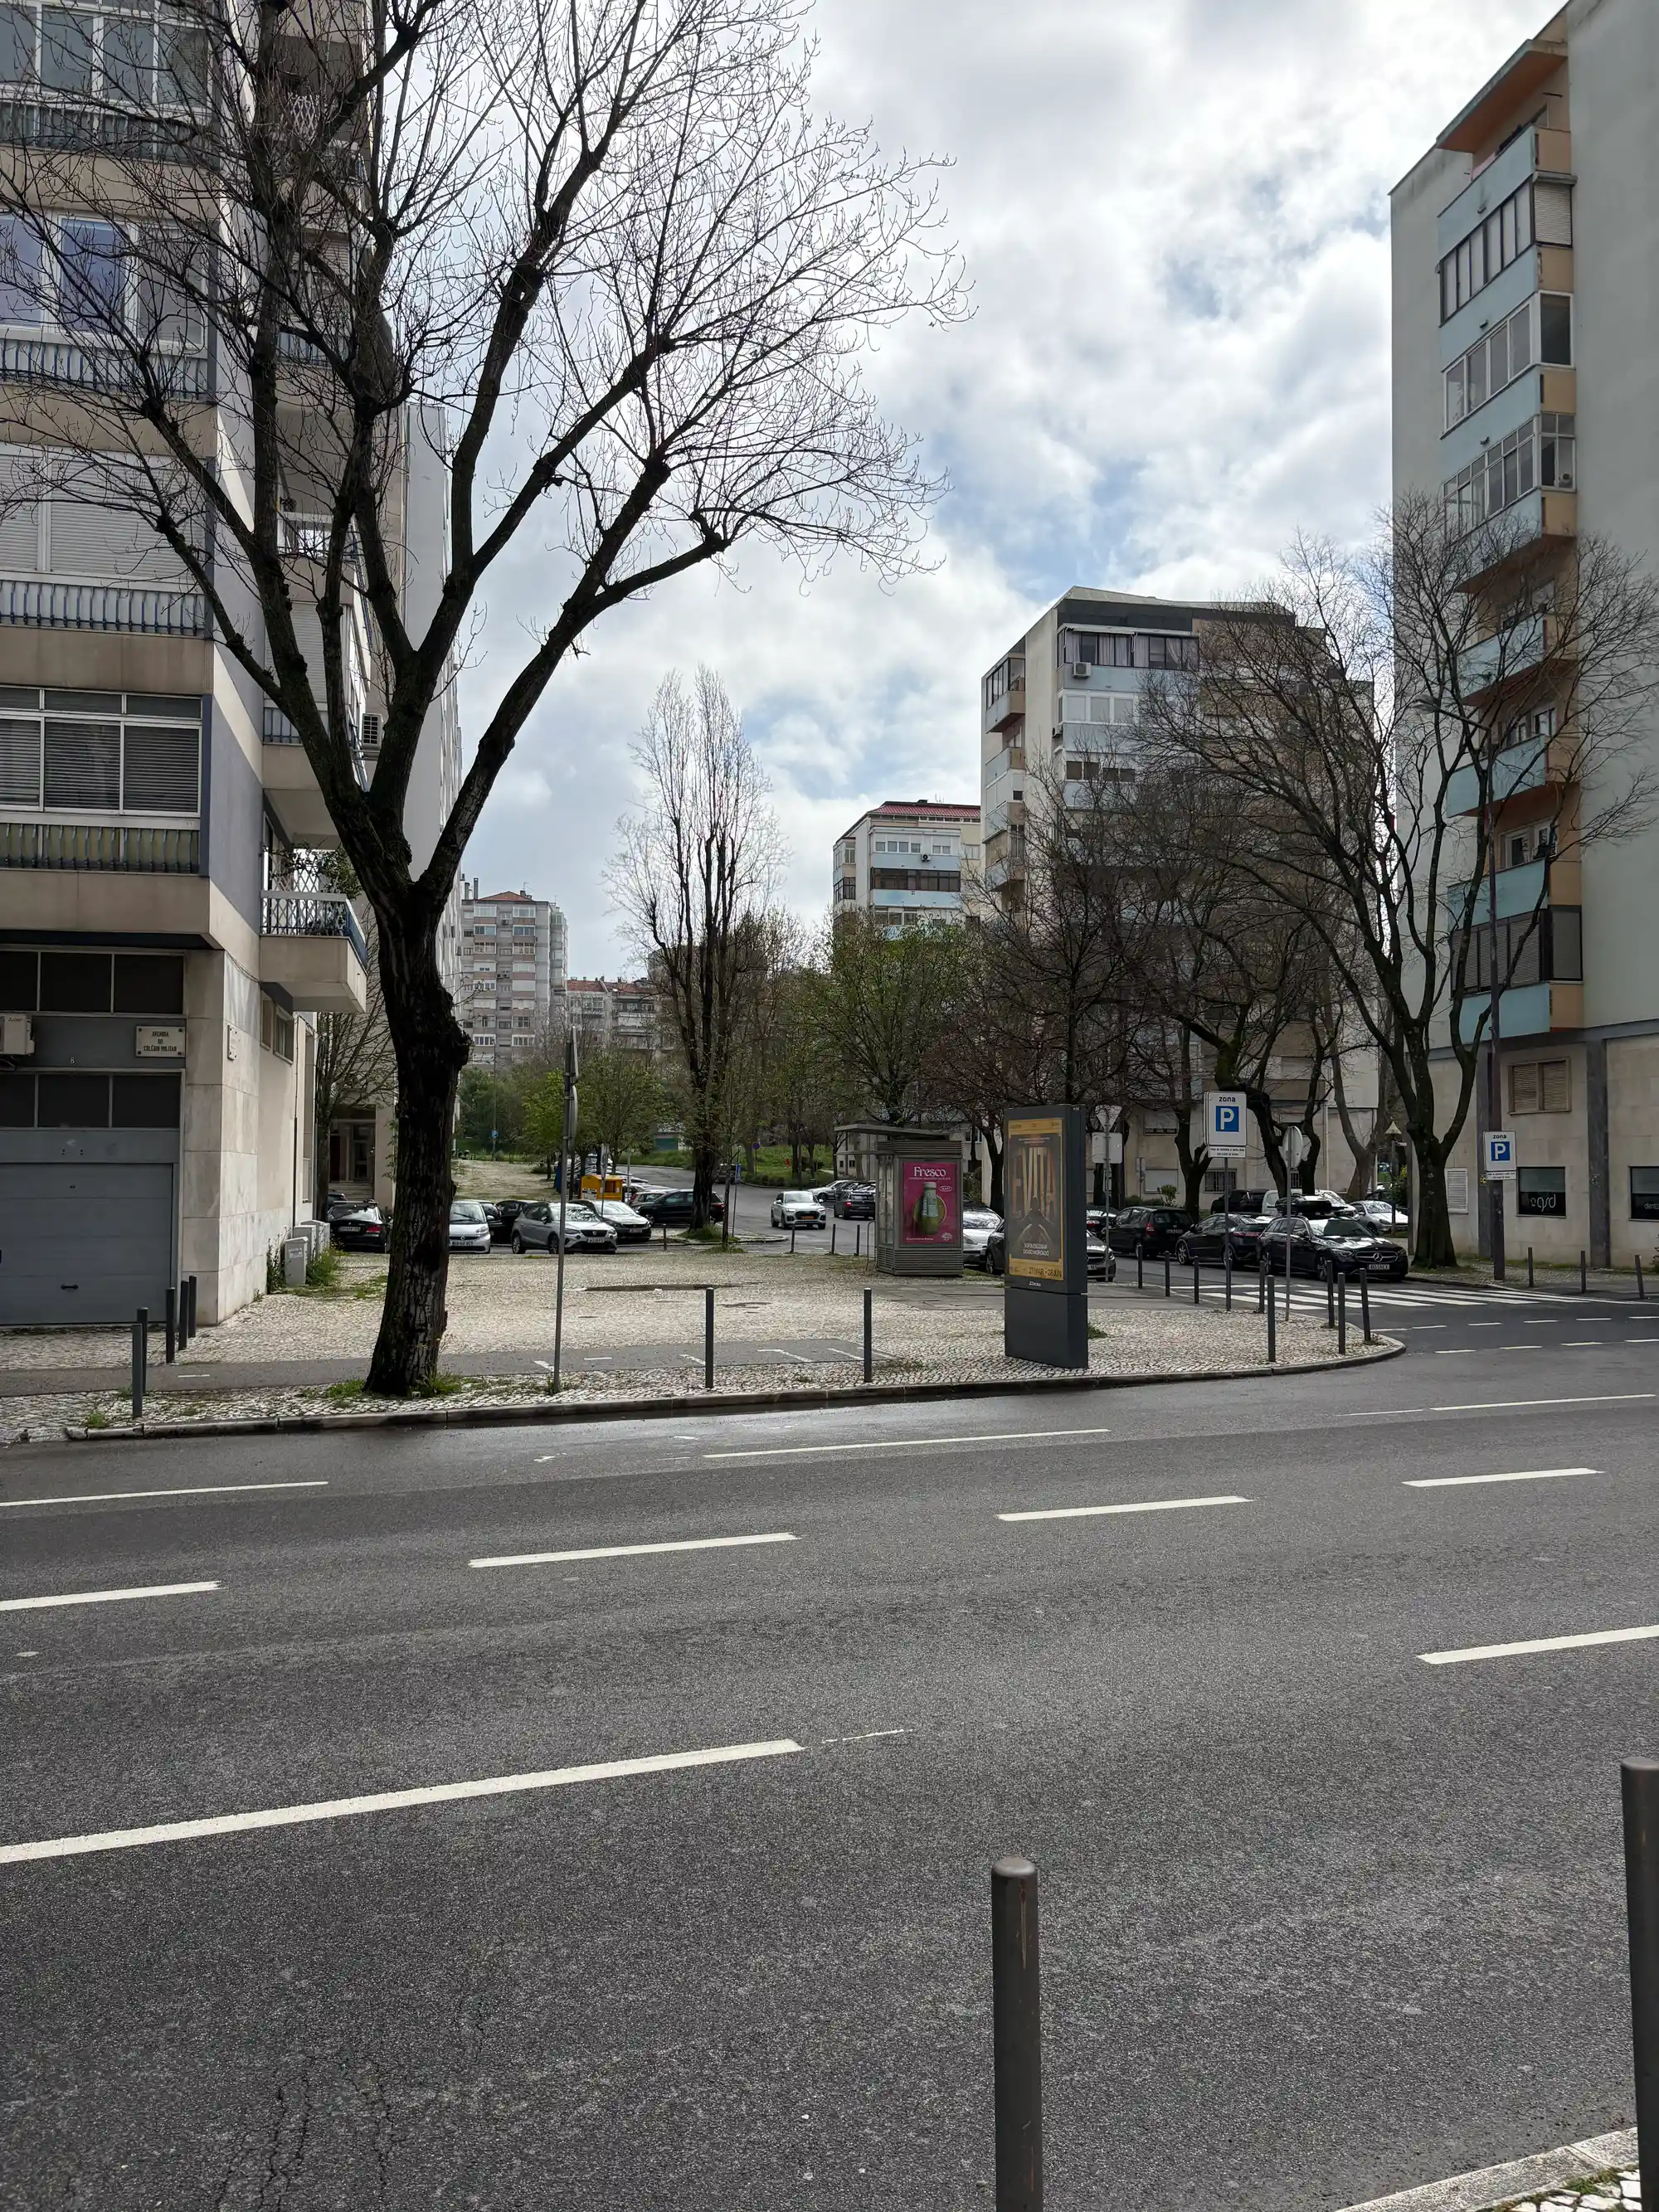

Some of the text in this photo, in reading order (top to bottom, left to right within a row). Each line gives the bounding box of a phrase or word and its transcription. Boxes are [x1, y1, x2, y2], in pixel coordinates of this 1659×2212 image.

[1220, 1107, 1234, 1130] P
[1494, 1142, 1506, 1159] P
[913, 1165, 946, 1177] Fresco
